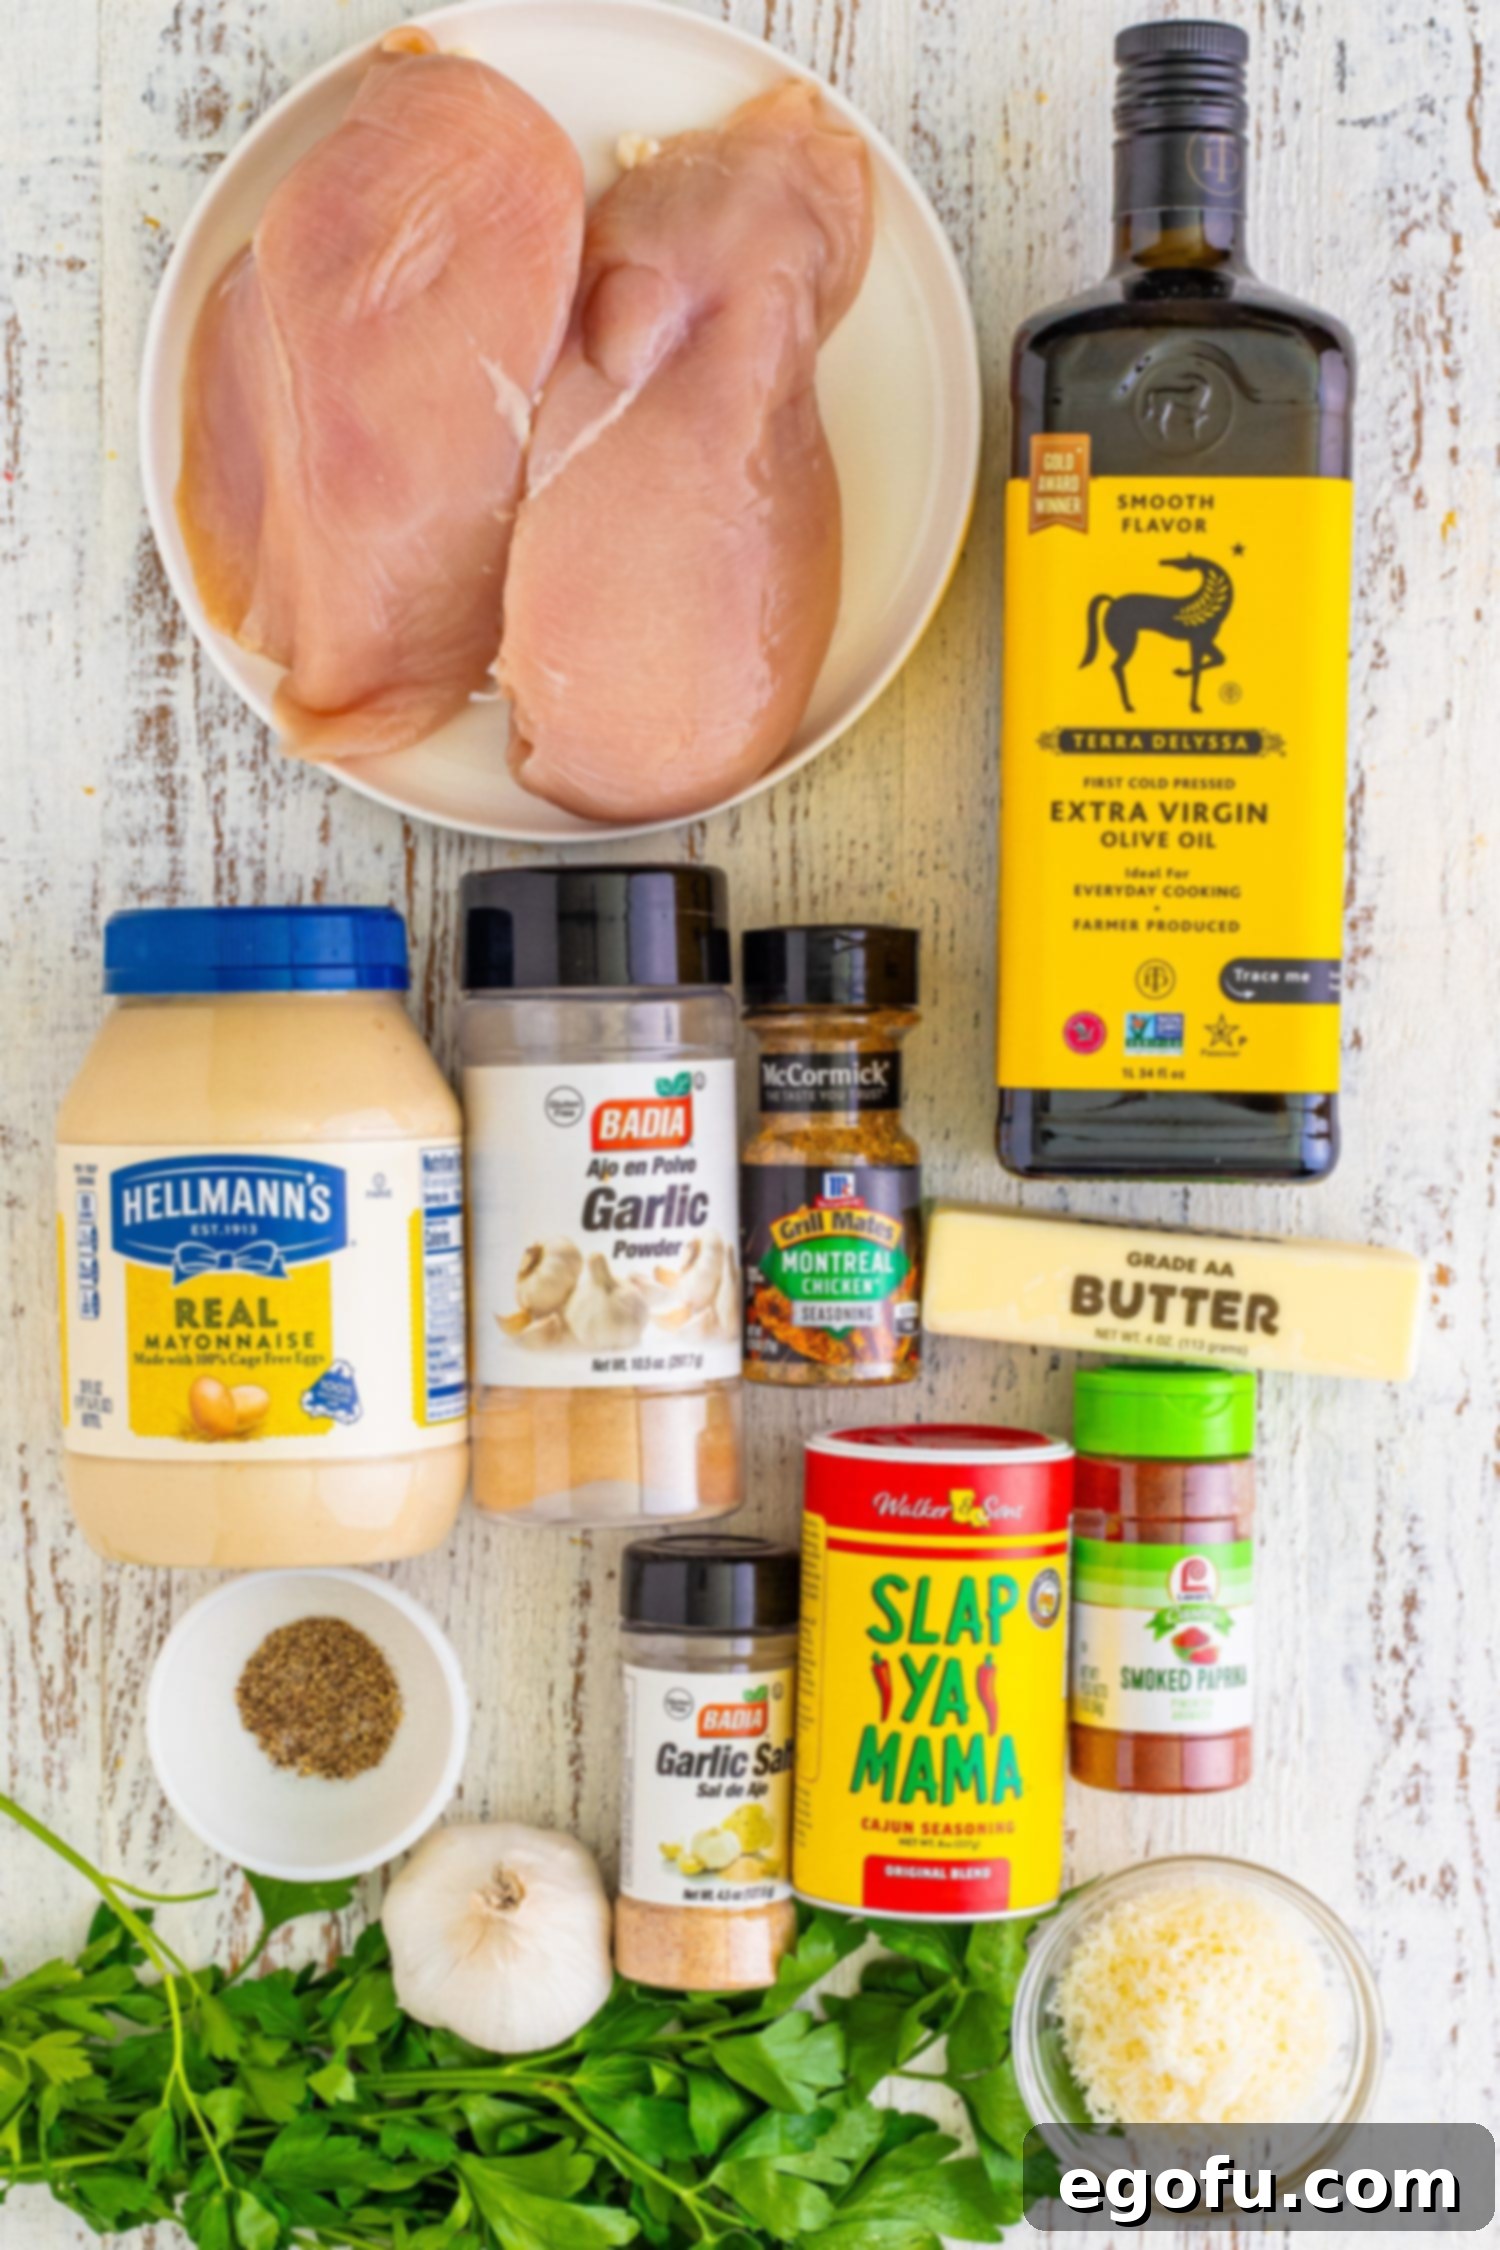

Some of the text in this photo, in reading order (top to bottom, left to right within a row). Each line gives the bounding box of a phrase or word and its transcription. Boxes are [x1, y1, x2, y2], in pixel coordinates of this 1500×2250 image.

[1043, 453, 1074, 470] GOLD
[1038, 475, 1079, 492] AWARD
[1036, 497, 1081, 514] WINNER
[1117, 495, 1215, 510] SMOOTH
[1122, 518, 1207, 533] FLAVOR
[1074, 734, 1249, 750] TERRA DELYSSA
[1083, 777, 1235, 790] FIRST COLD PRESSED
[1050, 801, 1269, 824] EXTRA VIRGIN
[1100, 831, 1216, 849] OLIVE OIL
[1125, 868, 1189, 879] Ideal For
[1074, 885, 1241, 898] EVERYDAY COOKING
[1073, 919, 1240, 933] FARMER PRODUCED
[1233, 968, 1310, 983] Trace me
[600, 1106, 685, 1140] BADIA
[587, 1156, 696, 1181] Ajo en Polvo
[122, 1173, 332, 1226] HELLMANN'S
[582, 1185, 708, 1232] Garlic
[780, 1212, 894, 1240] Grill Mates
[613, 1239, 682, 1259] Powder
[781, 1251, 894, 1274] MONTREAL
[1126, 1251, 1235, 1278] GRADE AA
[802, 1278, 873, 1295] CHICKEN
[175, 1298, 279, 1329] REAL
[801, 1306, 873, 1322] SEASONING
[1069, 1275, 1281, 1336] BUTTER
[145, 1332, 315, 1350] MAYONNAISE
[1095, 1328, 1118, 1340] NET
[134, 1353, 165, 1365] Made
[228, 1353, 262, 1369] Cage
[264, 1352, 292, 1364] Free
[295, 1351, 325, 1367] Eggs
[872, 1490, 950, 1518] Walker
[866, 1573, 1019, 1646] SLAP
[1120, 1666, 1192, 1692] SMOKED
[900, 1653, 968, 1727] YA
[703, 1708, 763, 1731] BADIA
[656, 1742, 748, 1778] Garlic
[850, 1724, 1023, 1807] MAMA
[697, 1783, 768, 1798] Sal de Ajo
[861, 1817, 1015, 1835] CAJUN SEASONING
[884, 1864, 991, 1880] ORIGINAL BLEND
